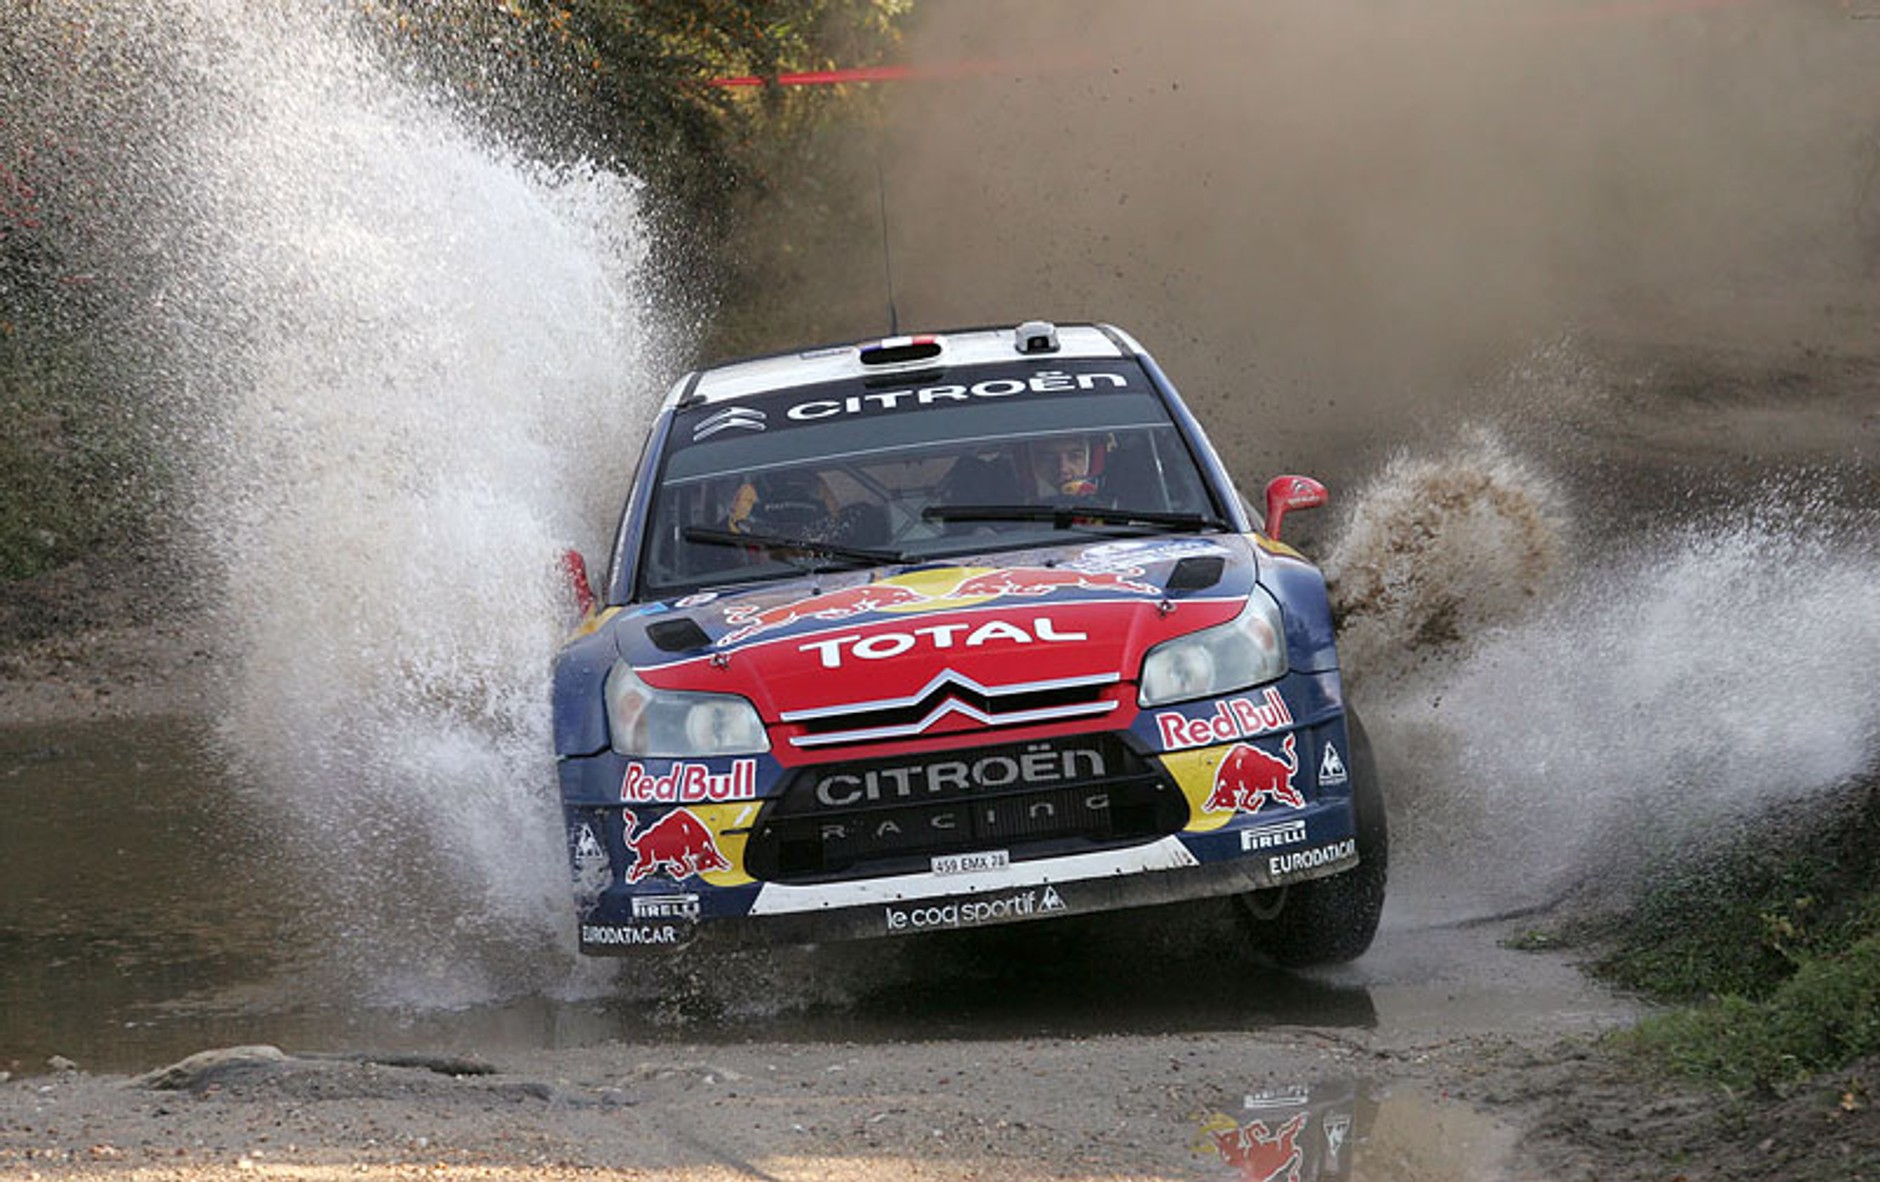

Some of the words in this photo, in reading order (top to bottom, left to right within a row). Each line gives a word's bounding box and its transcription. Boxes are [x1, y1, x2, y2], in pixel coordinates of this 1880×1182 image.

[799, 617, 1088, 668] TOTAL
[1155, 700, 1241, 751] Red
[1230, 686, 1294, 737] Bull
[620, 761, 682, 802] Red
[679, 758, 756, 802] Bull
[1240, 819, 1306, 852] PIRELLI
[961, 857, 989, 871] EMX
[886, 906, 908, 930] le
[911, 901, 959, 928] coq
[961, 890, 1036, 926] sportif
